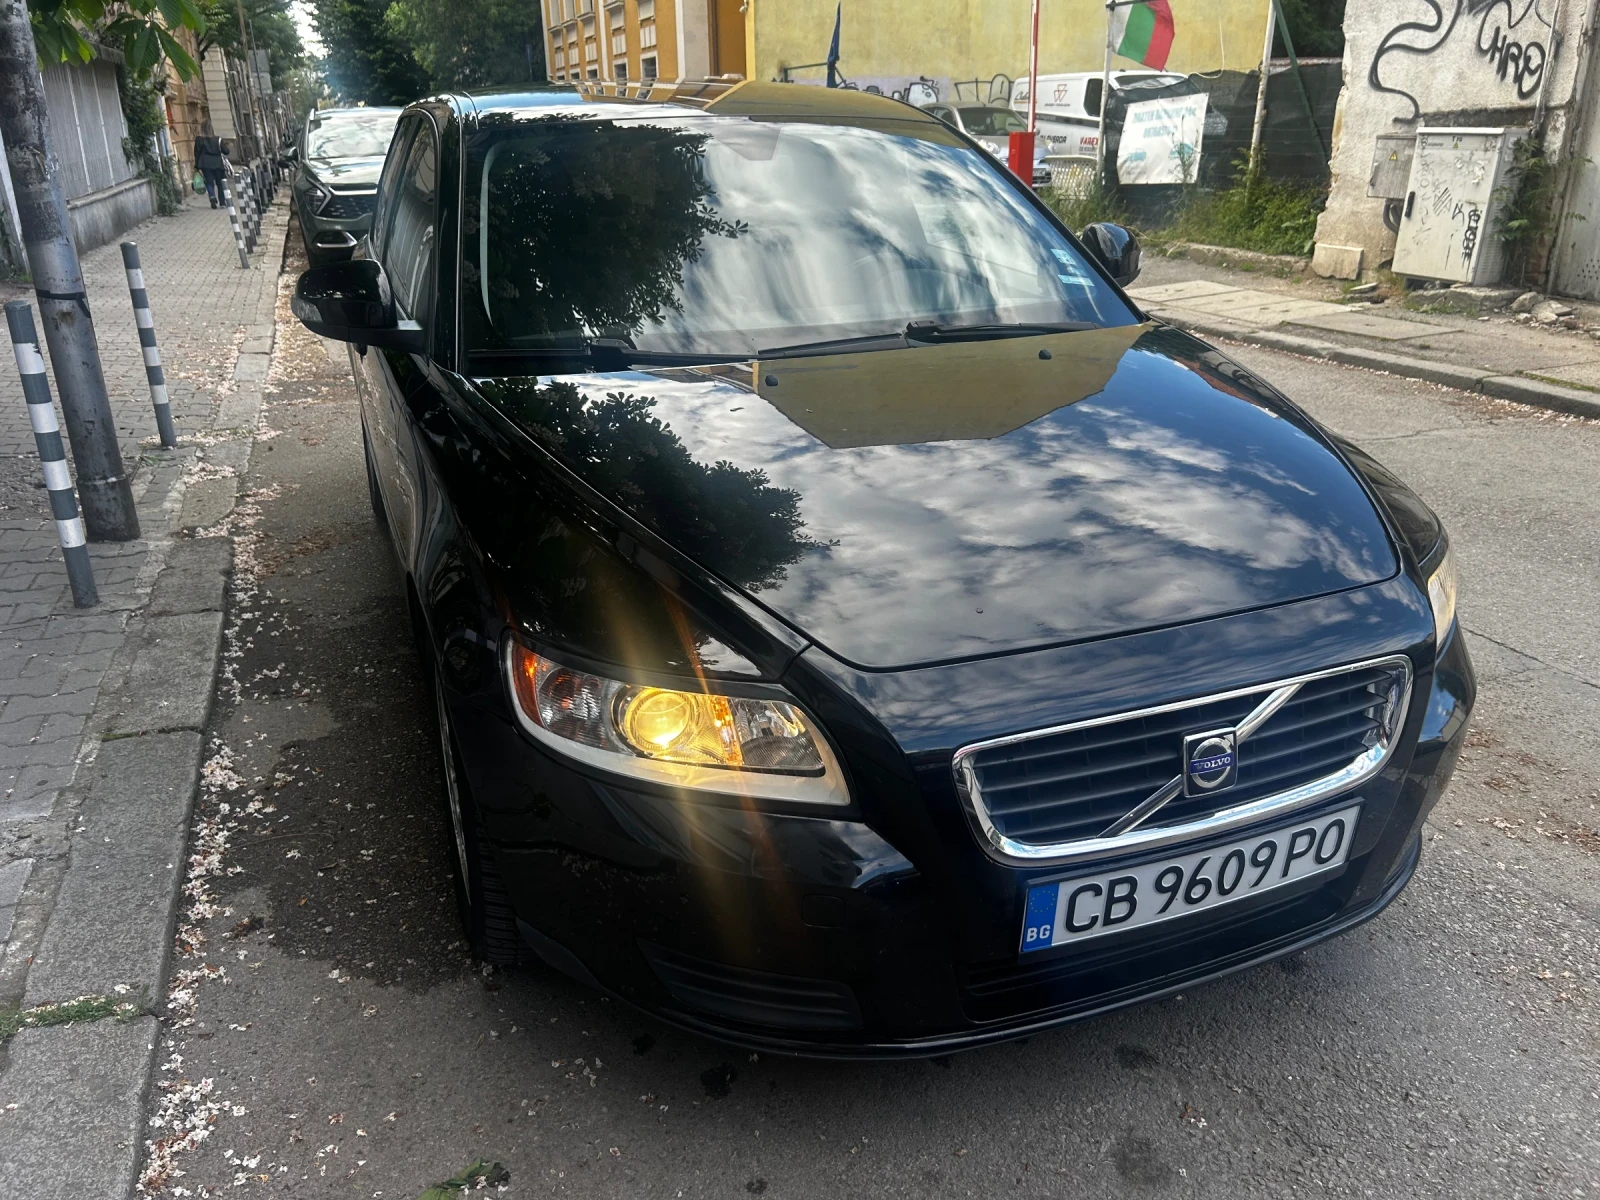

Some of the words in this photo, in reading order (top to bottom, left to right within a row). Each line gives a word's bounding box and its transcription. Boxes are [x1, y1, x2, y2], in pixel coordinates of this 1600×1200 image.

[1193, 756, 1231, 770] VOLVO
[1065, 874, 1139, 933] CB
[1154, 839, 1278, 915] 9609
[1026, 924, 1051, 942] BG
